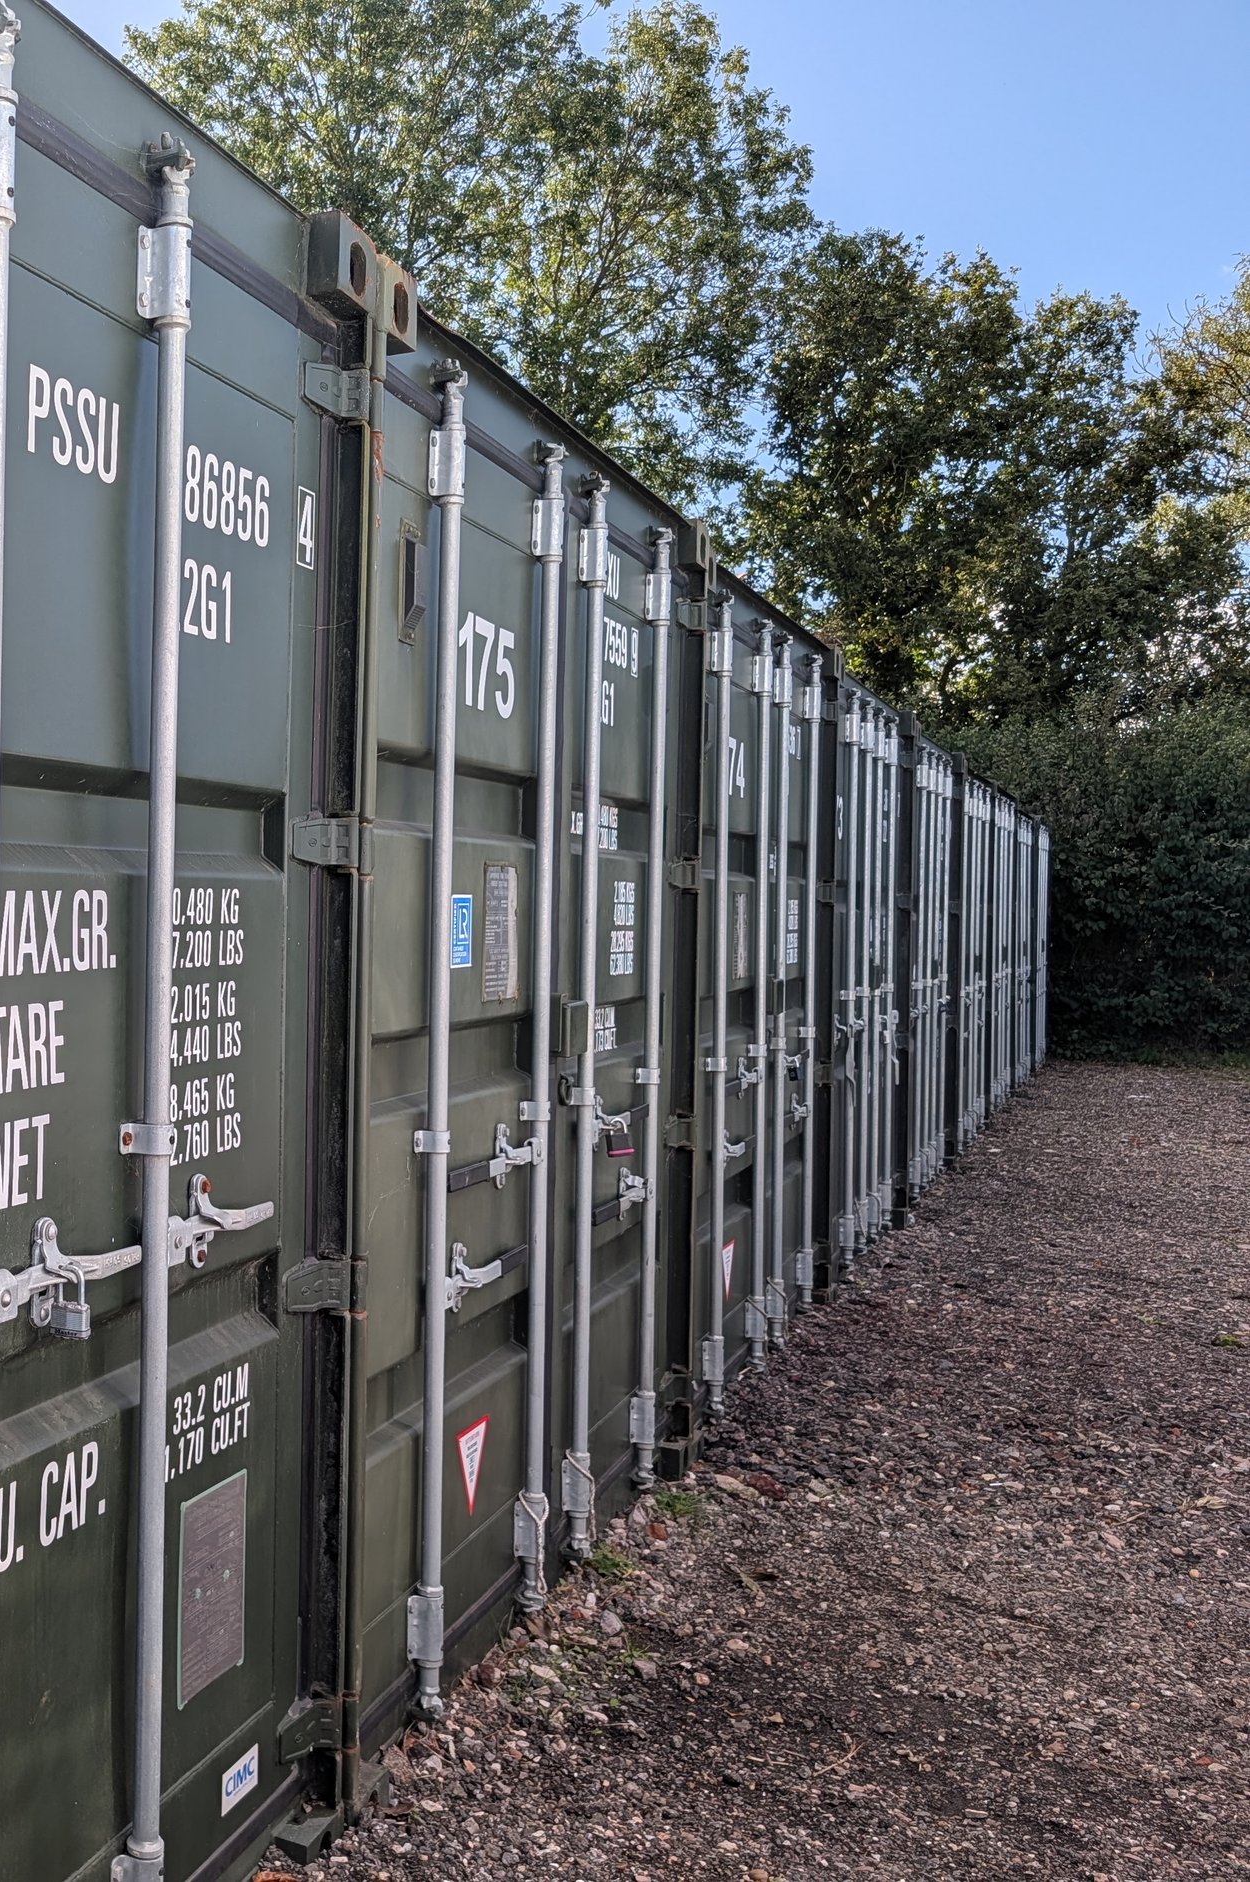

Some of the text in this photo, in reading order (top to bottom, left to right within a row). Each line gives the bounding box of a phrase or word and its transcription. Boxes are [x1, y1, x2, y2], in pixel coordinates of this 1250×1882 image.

[27, 363, 120, 484] PSSU
[298, 492, 315, 566] 4
[178, 558, 233, 644] 2G1
[459, 611, 515, 719] 175
[631, 629, 638, 675] 9
[600, 680, 615, 726] G1
[729, 736, 745, 799] 74
[220, 888, 240, 925] KG
[218, 929, 244, 966] LBS
[170, 980, 237, 1024] 2,015 KG
[169, 1021, 242, 1067] 4,440 LBS
[216, 1072, 235, 1112] KG
[216, 1113, 242, 1154] LBS
[54, 1328, 78, 1337] Master
[173, 1362, 249, 1435] 33.2 CU.M
[164, 1402, 251, 1483] 1,170 CU.FT
[39, 1440, 106, 1547] CAP.
[225, 1755, 255, 1797] CIMC
